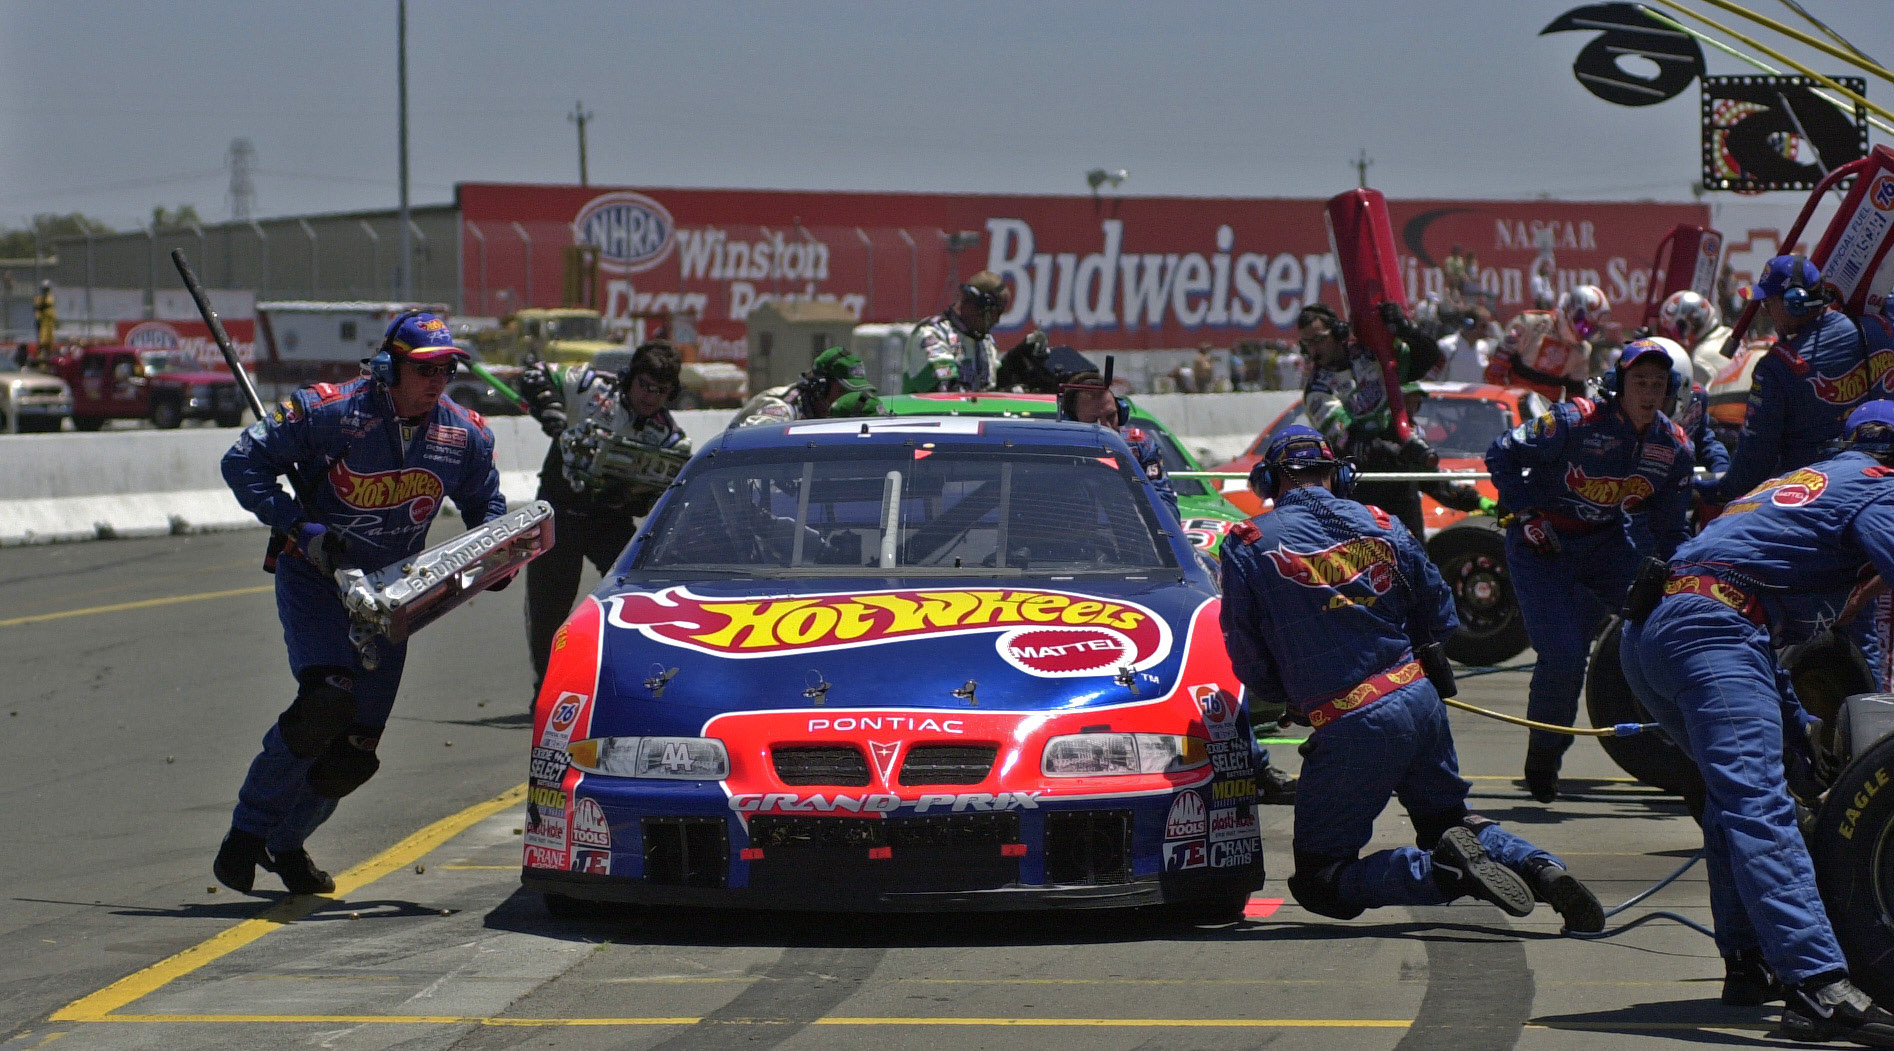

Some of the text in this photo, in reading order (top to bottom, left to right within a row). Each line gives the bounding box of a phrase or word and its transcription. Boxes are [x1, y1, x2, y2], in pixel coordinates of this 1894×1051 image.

[1851, 206, 1872, 233] FUEL
[590, 206, 662, 258] NHRA
[674, 228, 829, 280] Winston
[985, 217, 1338, 331] Budweiser
[1010, 637, 1126, 659] MATTEL
[552, 703, 579, 724] 76
[1200, 692, 1220, 714] 76
[808, 717, 964, 734] PONTIAC
[660, 743, 695, 771] 44
[1212, 751, 1250, 773] SELECT
[531, 760, 566, 781] SELECT
[528, 787, 566, 808] MOOG
[1212, 780, 1256, 800] MOOG
[728, 791, 1043, 813] GRAND PRIX
[1169, 793, 1204, 825] MAC
[1839, 767, 1891, 840] EAGLE
[574, 801, 605, 833] MAC
[573, 830, 608, 845] TOOLS
[1168, 821, 1205, 836] TOOLS
[524, 846, 567, 868] CRANE
[1211, 837, 1260, 868] CRANE
